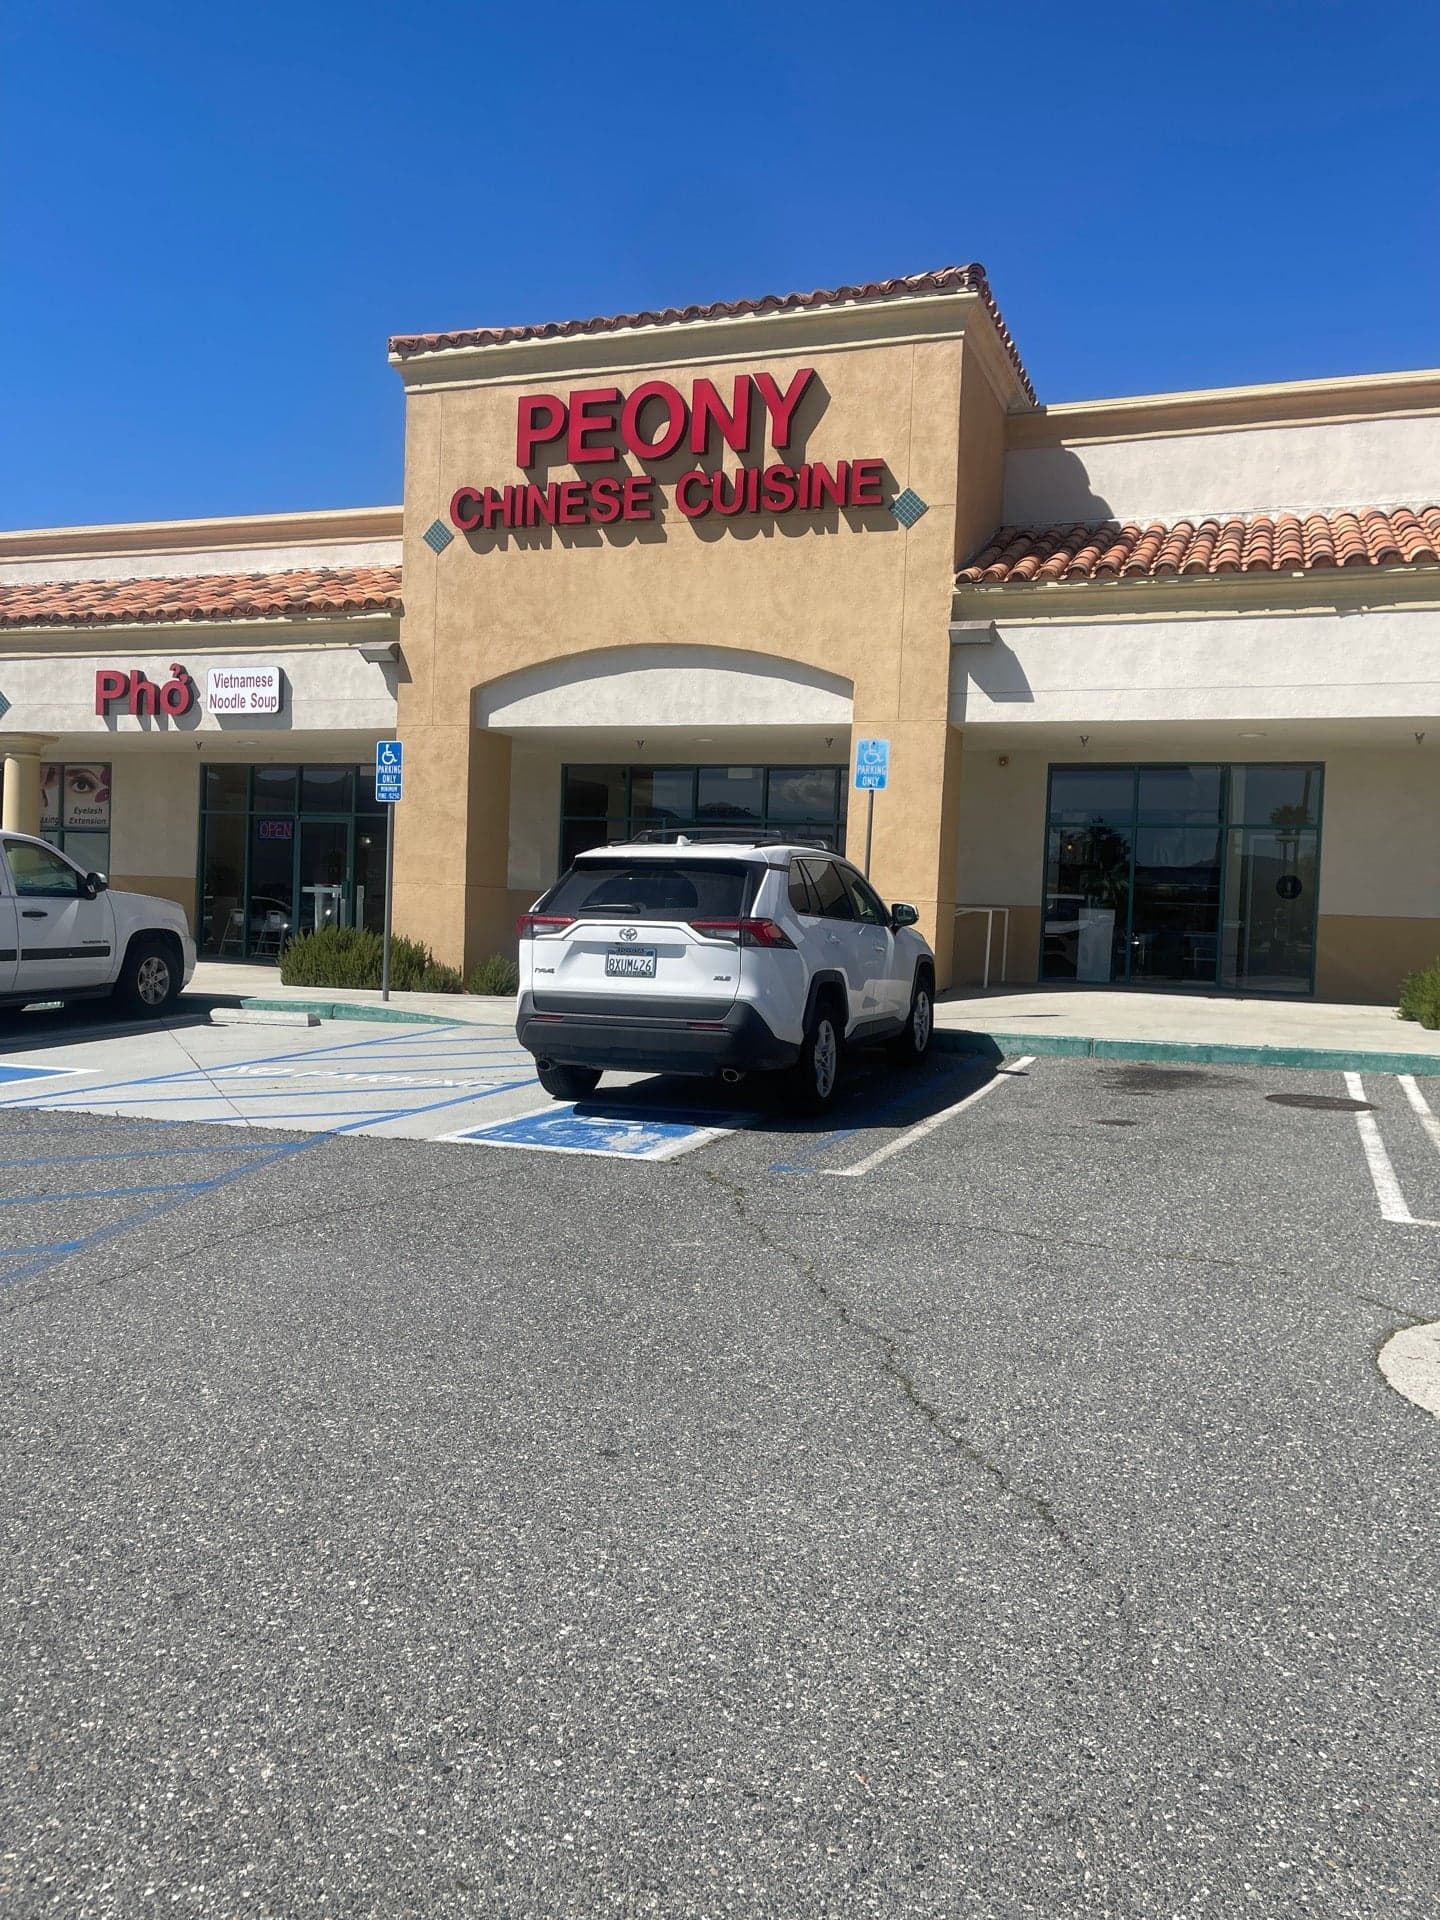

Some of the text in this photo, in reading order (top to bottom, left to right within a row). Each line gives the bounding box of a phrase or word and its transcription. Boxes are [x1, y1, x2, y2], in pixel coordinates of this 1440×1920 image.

[516, 368, 815, 469] PEONY
[449, 458, 887, 532] CHINESE CUISINE
[213, 673, 273, 689] Vietnamese
[95, 662, 193, 716] Phở
[209, 692, 277, 711] Noodle Soup
[378, 765, 401, 774] PARKING
[857, 764, 886, 775] PARKING
[382, 774, 397, 783] ONLY
[862, 776, 880, 787] ONLY
[73, 806, 103, 815] Eyelash
[40, 815, 59, 826] axing
[69, 816, 107, 825] Extension
[259, 821, 293, 837] OPEN
[608, 958, 652, 972] 8XUM426
